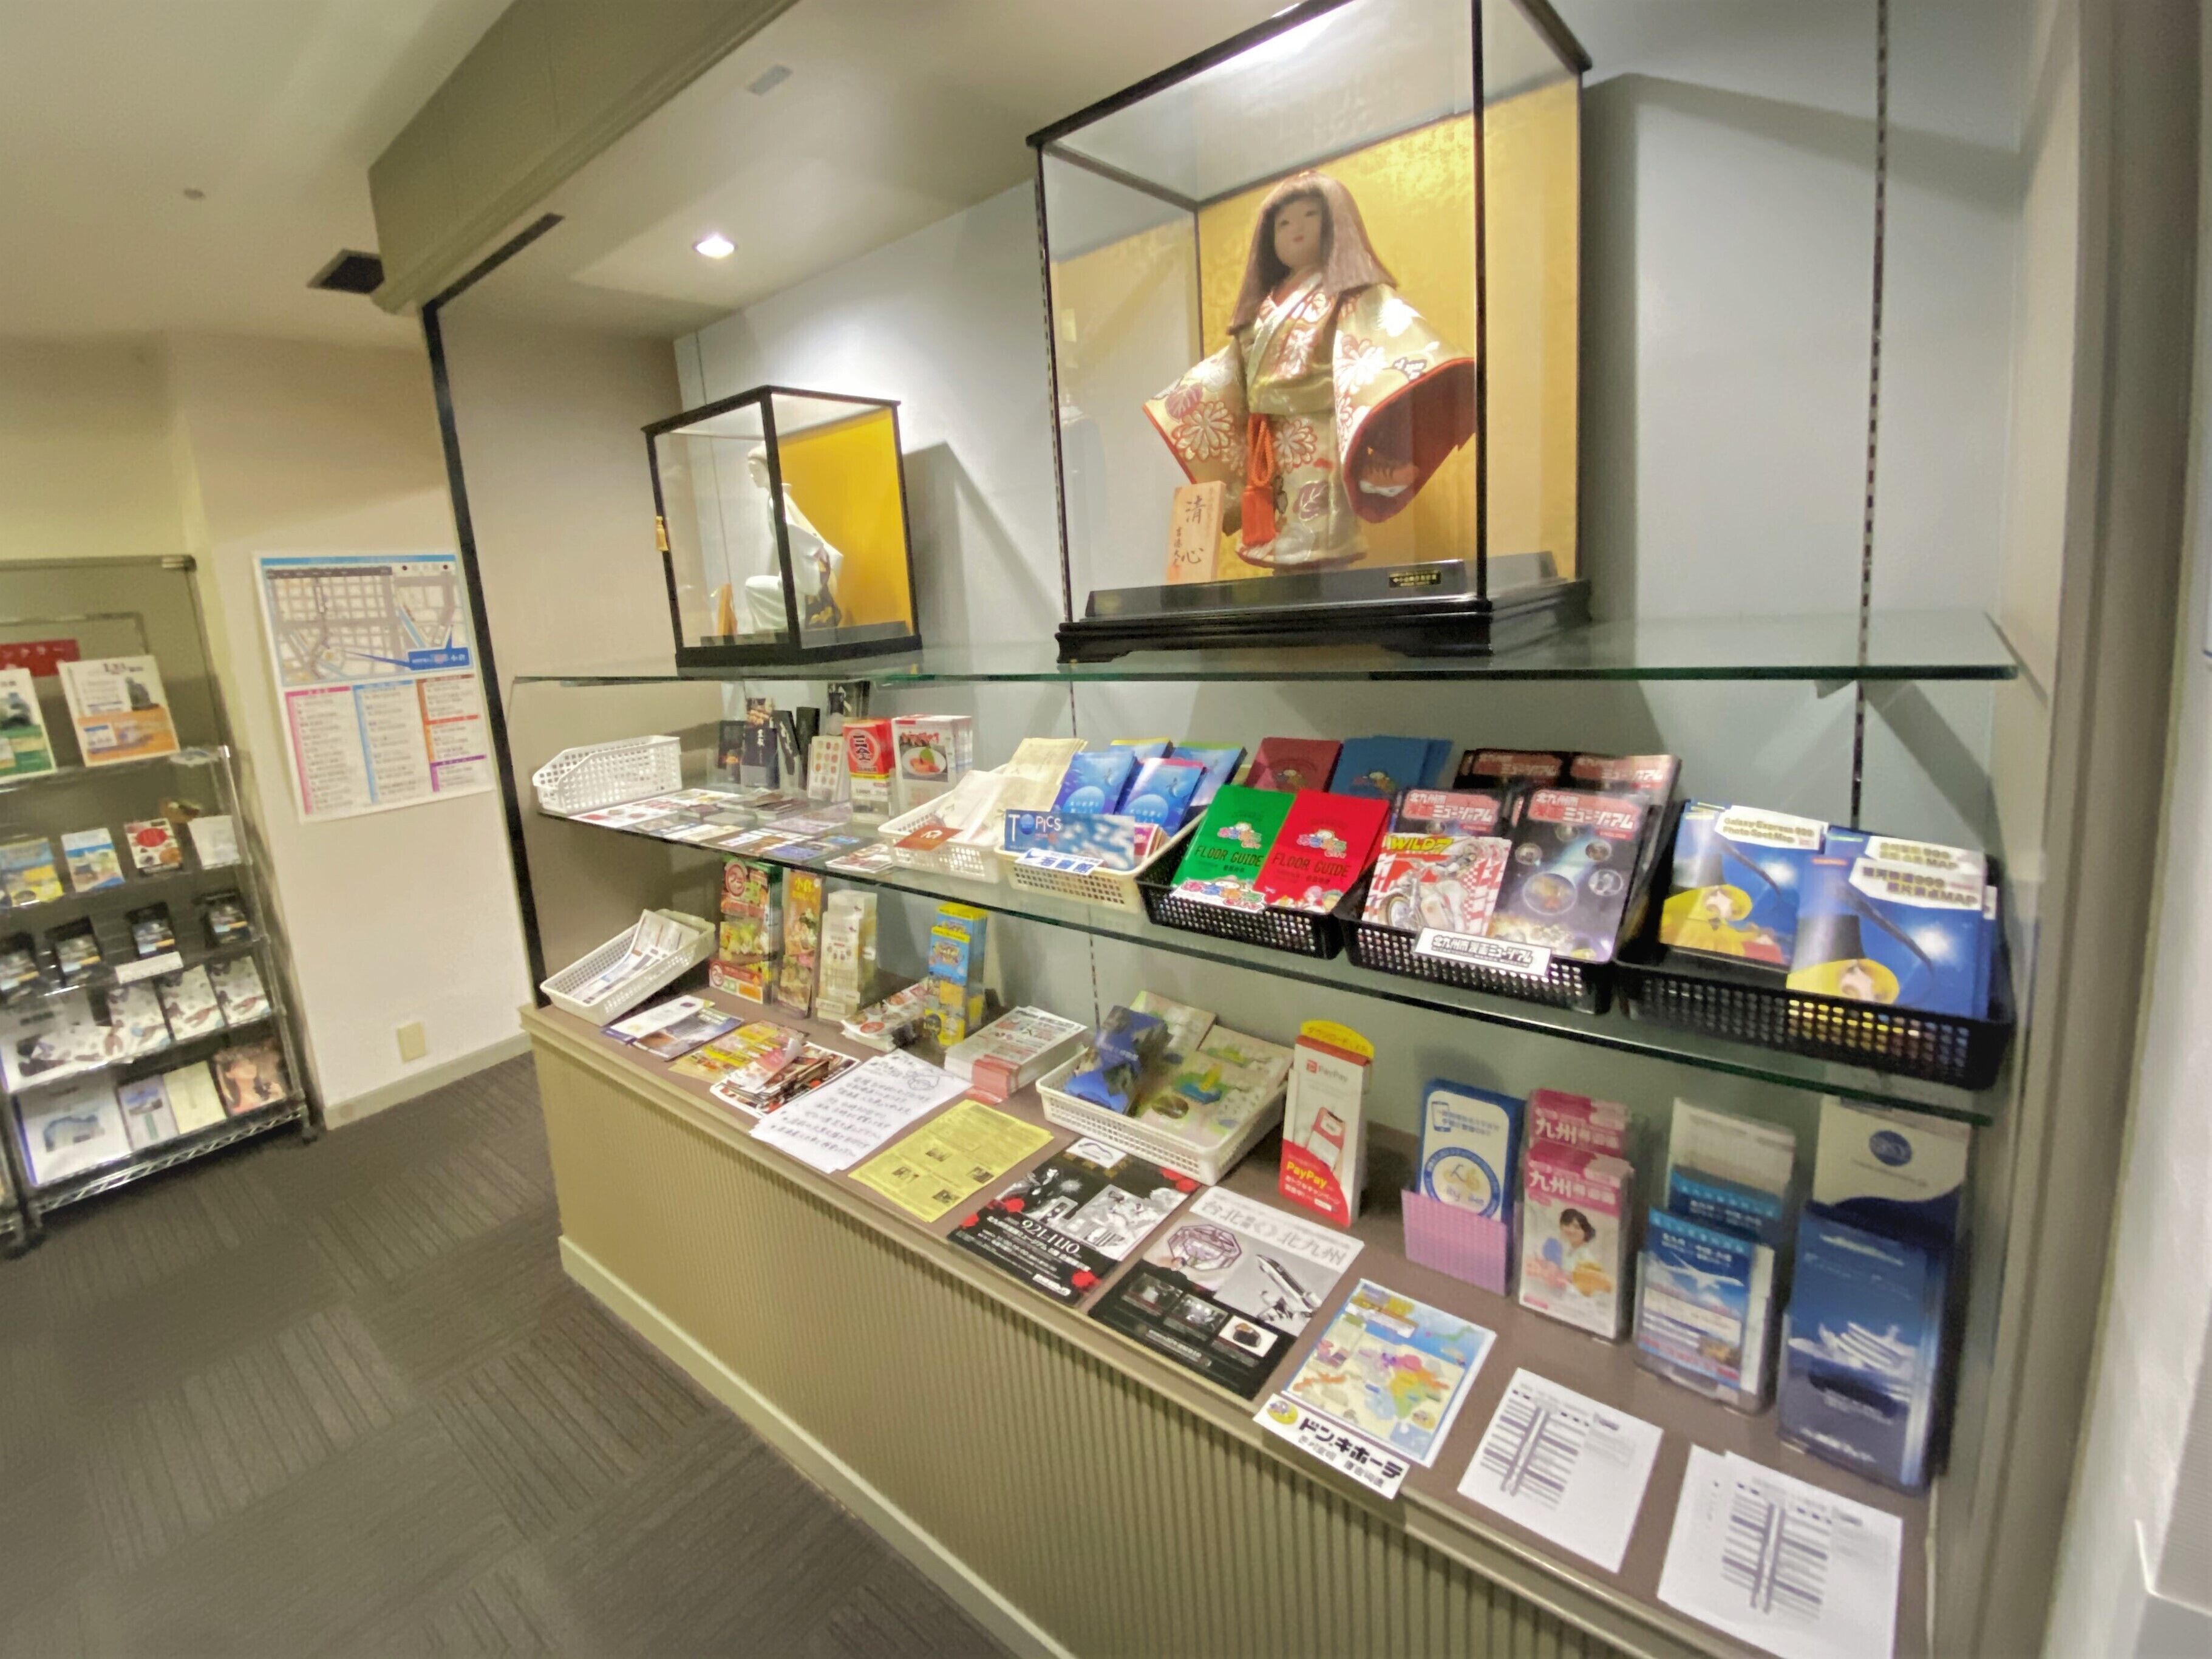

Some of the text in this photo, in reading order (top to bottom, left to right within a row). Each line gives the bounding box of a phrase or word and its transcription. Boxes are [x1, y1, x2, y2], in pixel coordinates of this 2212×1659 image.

[1181, 495, 1205, 564] 清心
[1195, 845, 1264, 867] FLOOR GUIDE
[1273, 852, 1351, 877] FLOOR GUIDE
[1286, 1160, 1328, 1190] PayPay
